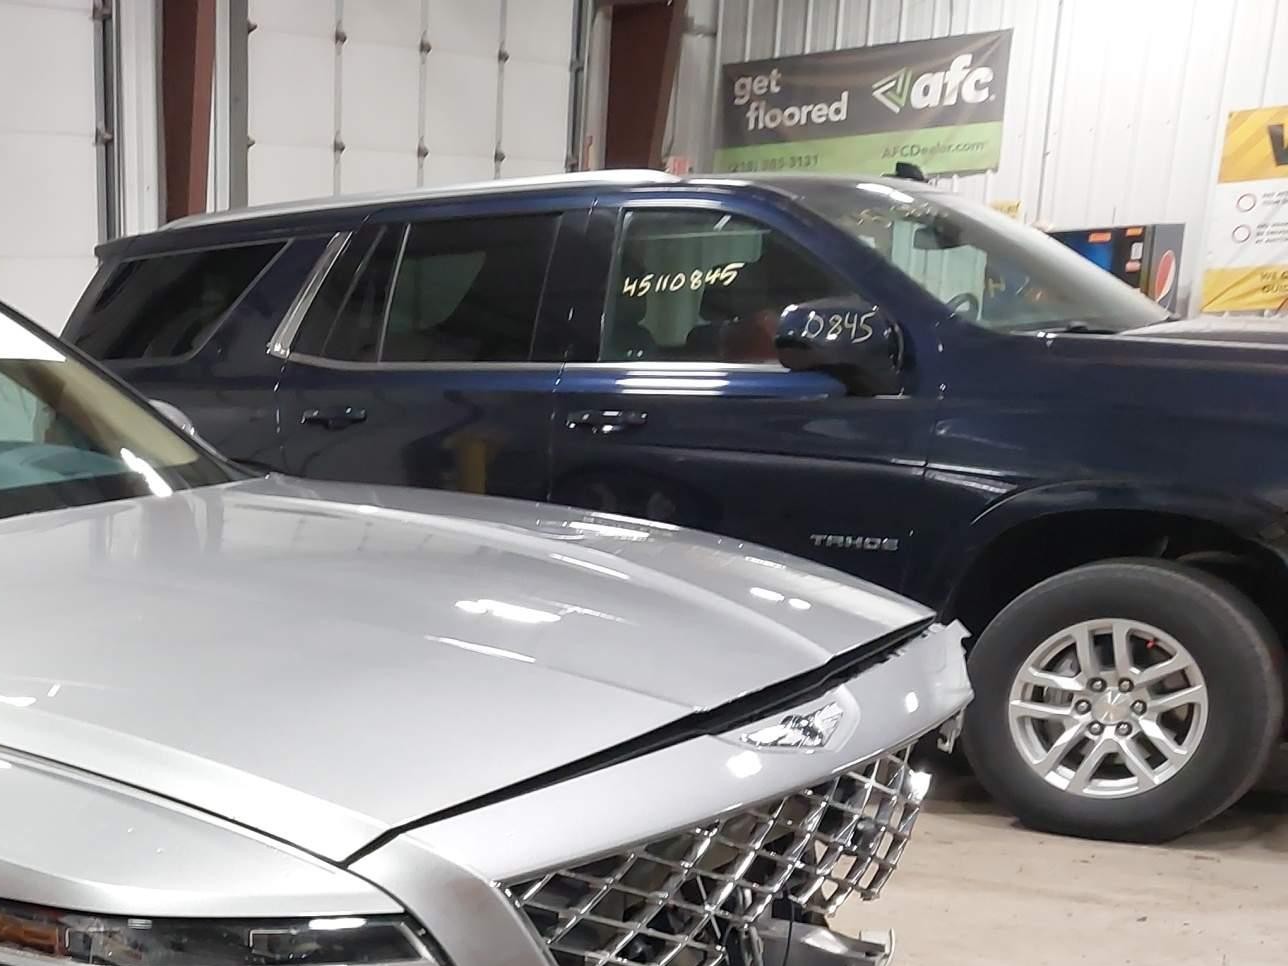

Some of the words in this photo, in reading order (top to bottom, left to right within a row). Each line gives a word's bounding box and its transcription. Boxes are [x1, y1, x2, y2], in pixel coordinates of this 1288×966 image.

[733, 67, 782, 105] get
[745, 91, 849, 131] floored
[622, 262, 745, 297] 45110845
